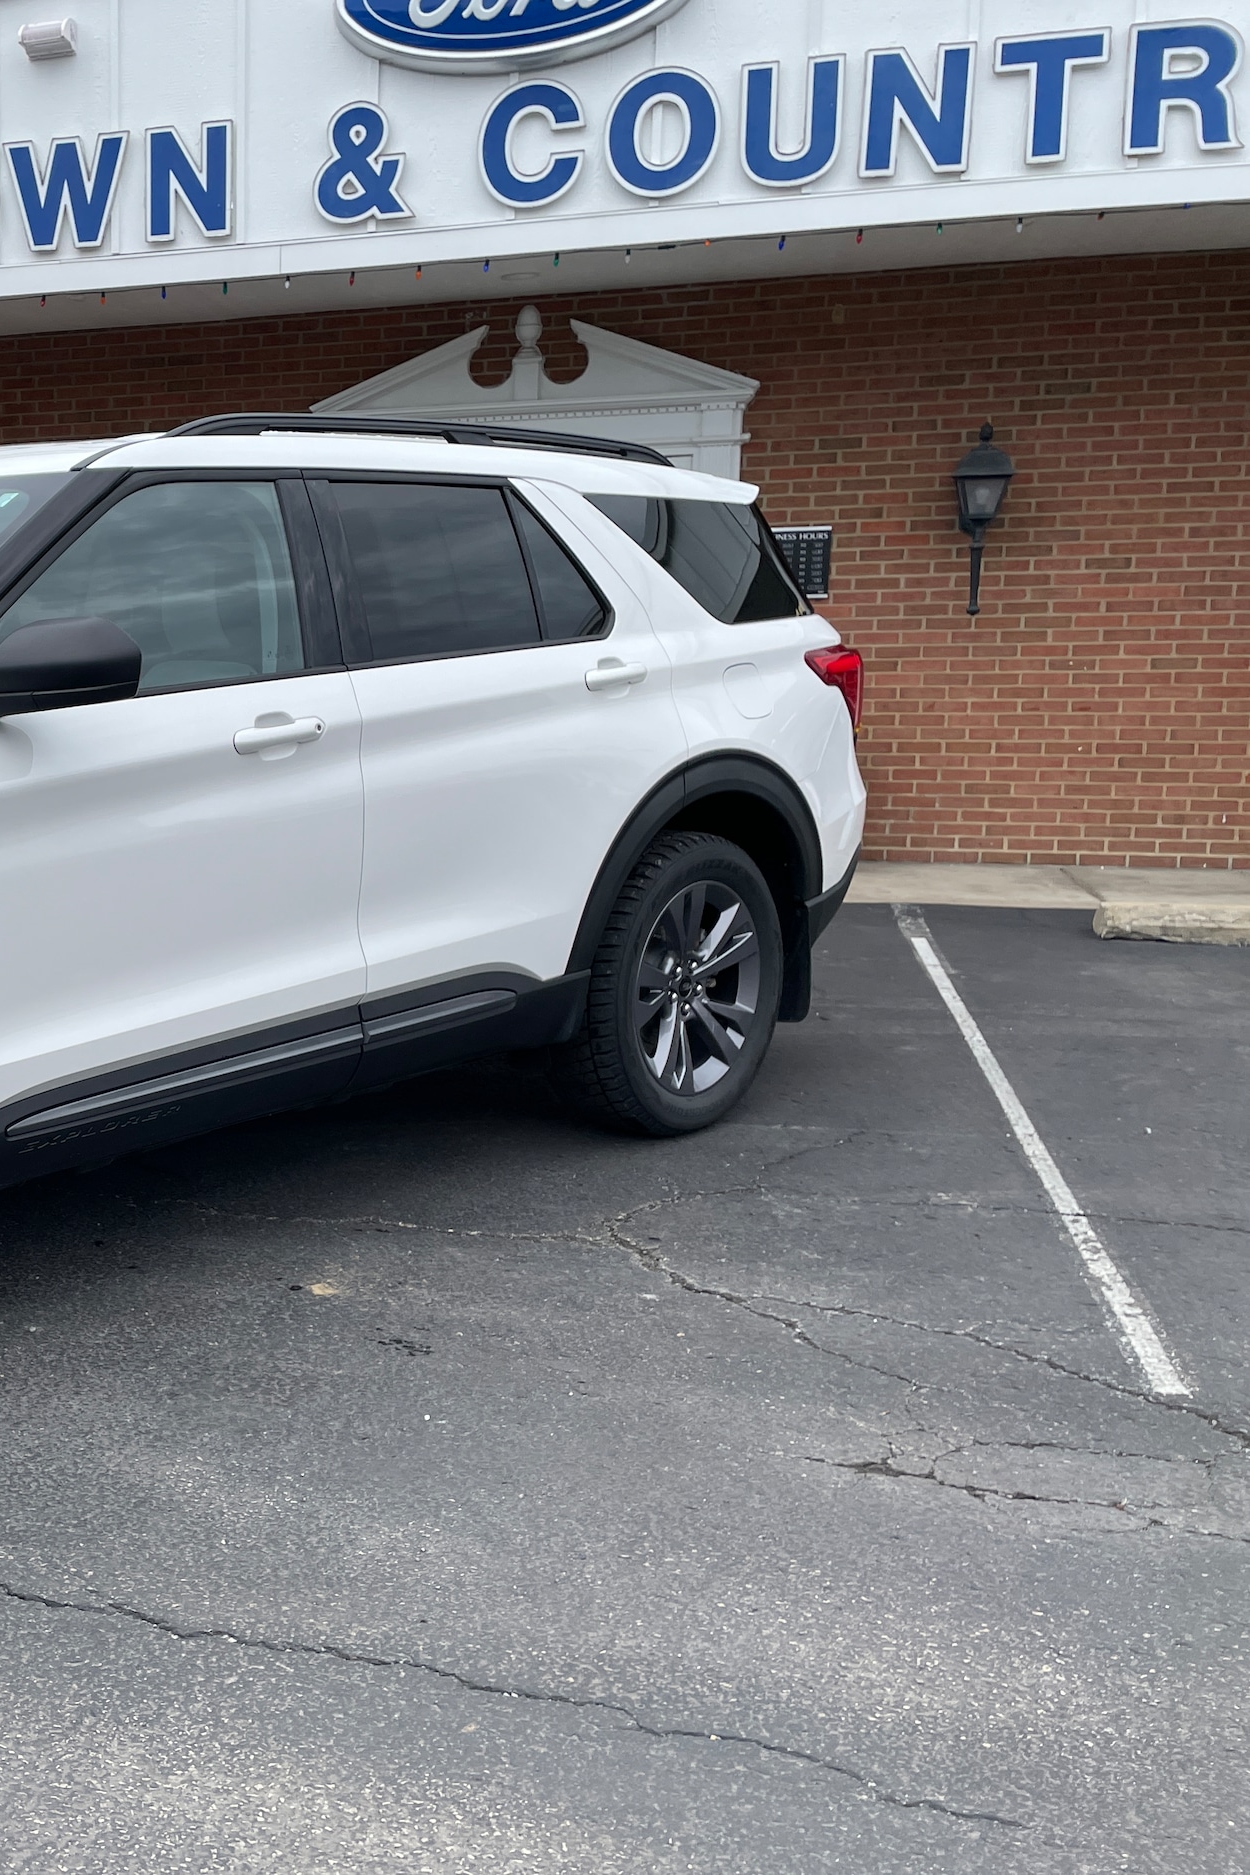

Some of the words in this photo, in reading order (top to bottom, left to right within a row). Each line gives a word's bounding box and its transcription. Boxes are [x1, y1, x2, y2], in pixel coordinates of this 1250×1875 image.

[314, 100, 415, 224] &
[479, 18, 1243, 208] COUNTR
[799, 532, 829, 541] HOURS
[17, 1104, 182, 1155] EXPLORER
